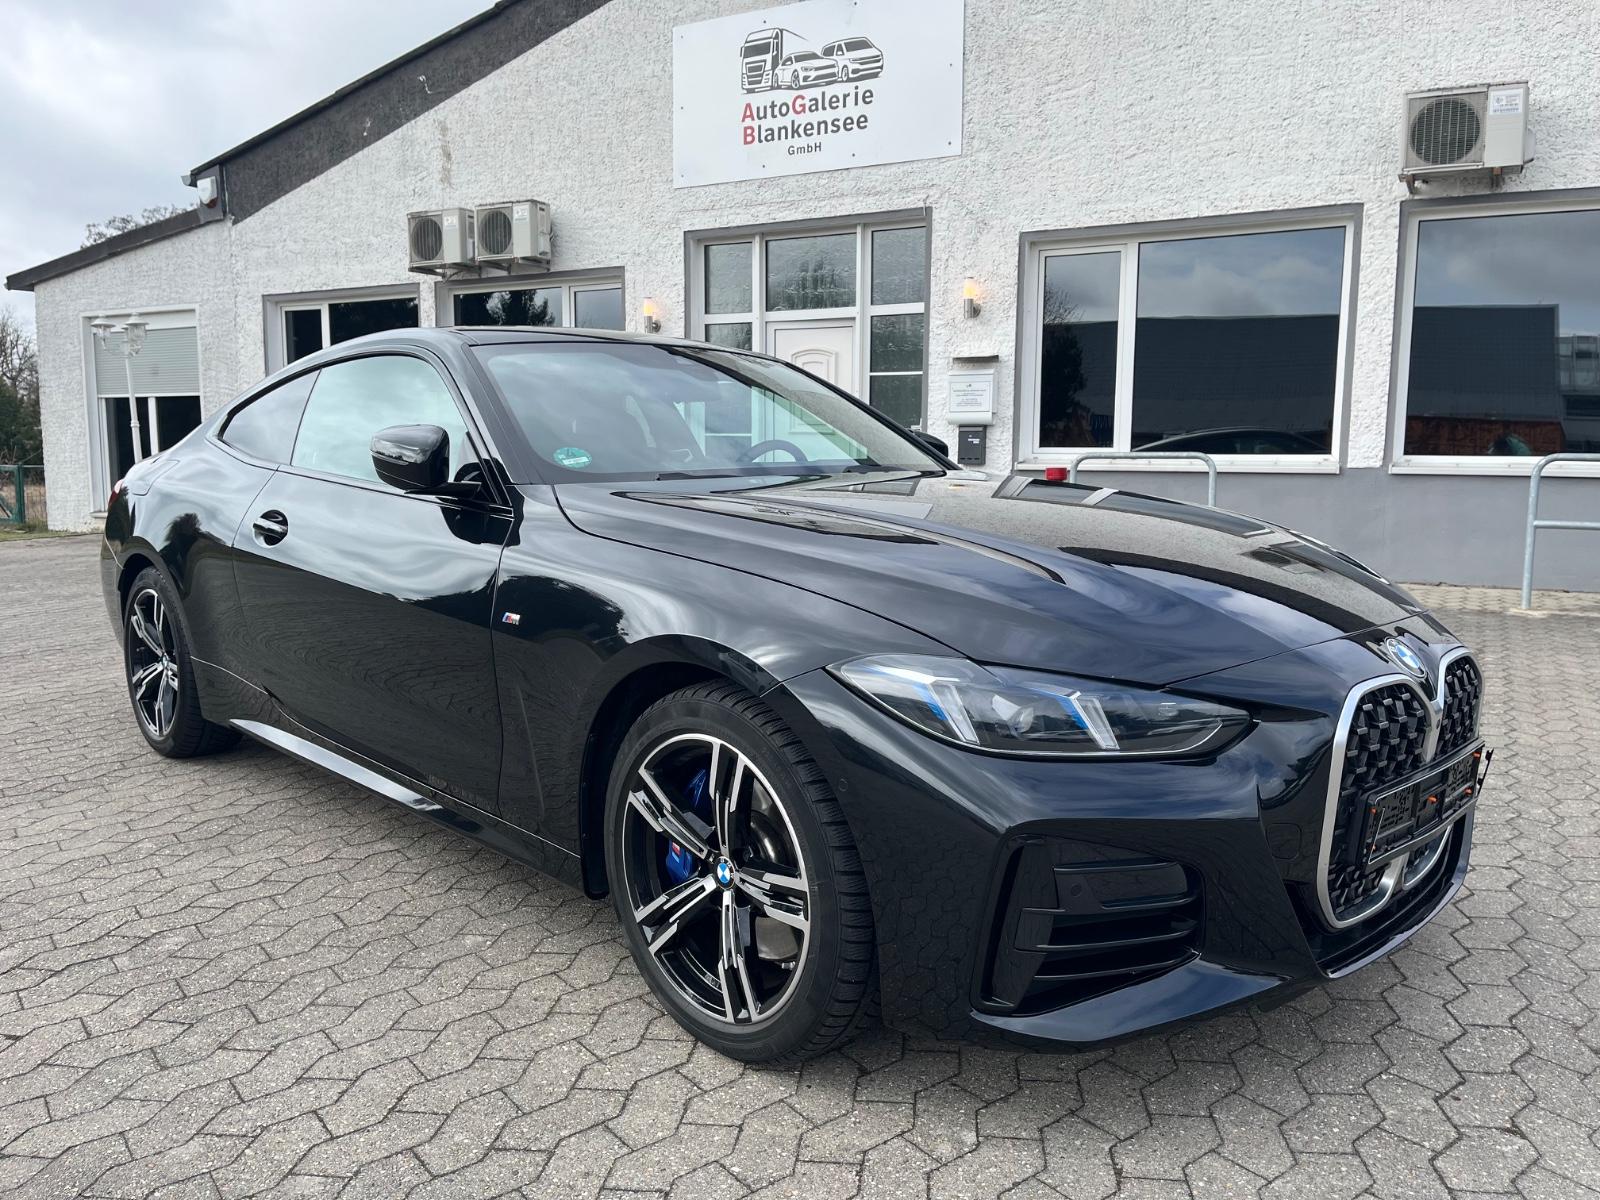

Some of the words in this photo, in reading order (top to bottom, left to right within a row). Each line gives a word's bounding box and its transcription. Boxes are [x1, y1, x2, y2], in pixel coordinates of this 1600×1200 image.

[742, 86, 874, 122] AutoGalerie
[743, 113, 868, 145] Blankensee
[787, 142, 822, 156] GmbH
